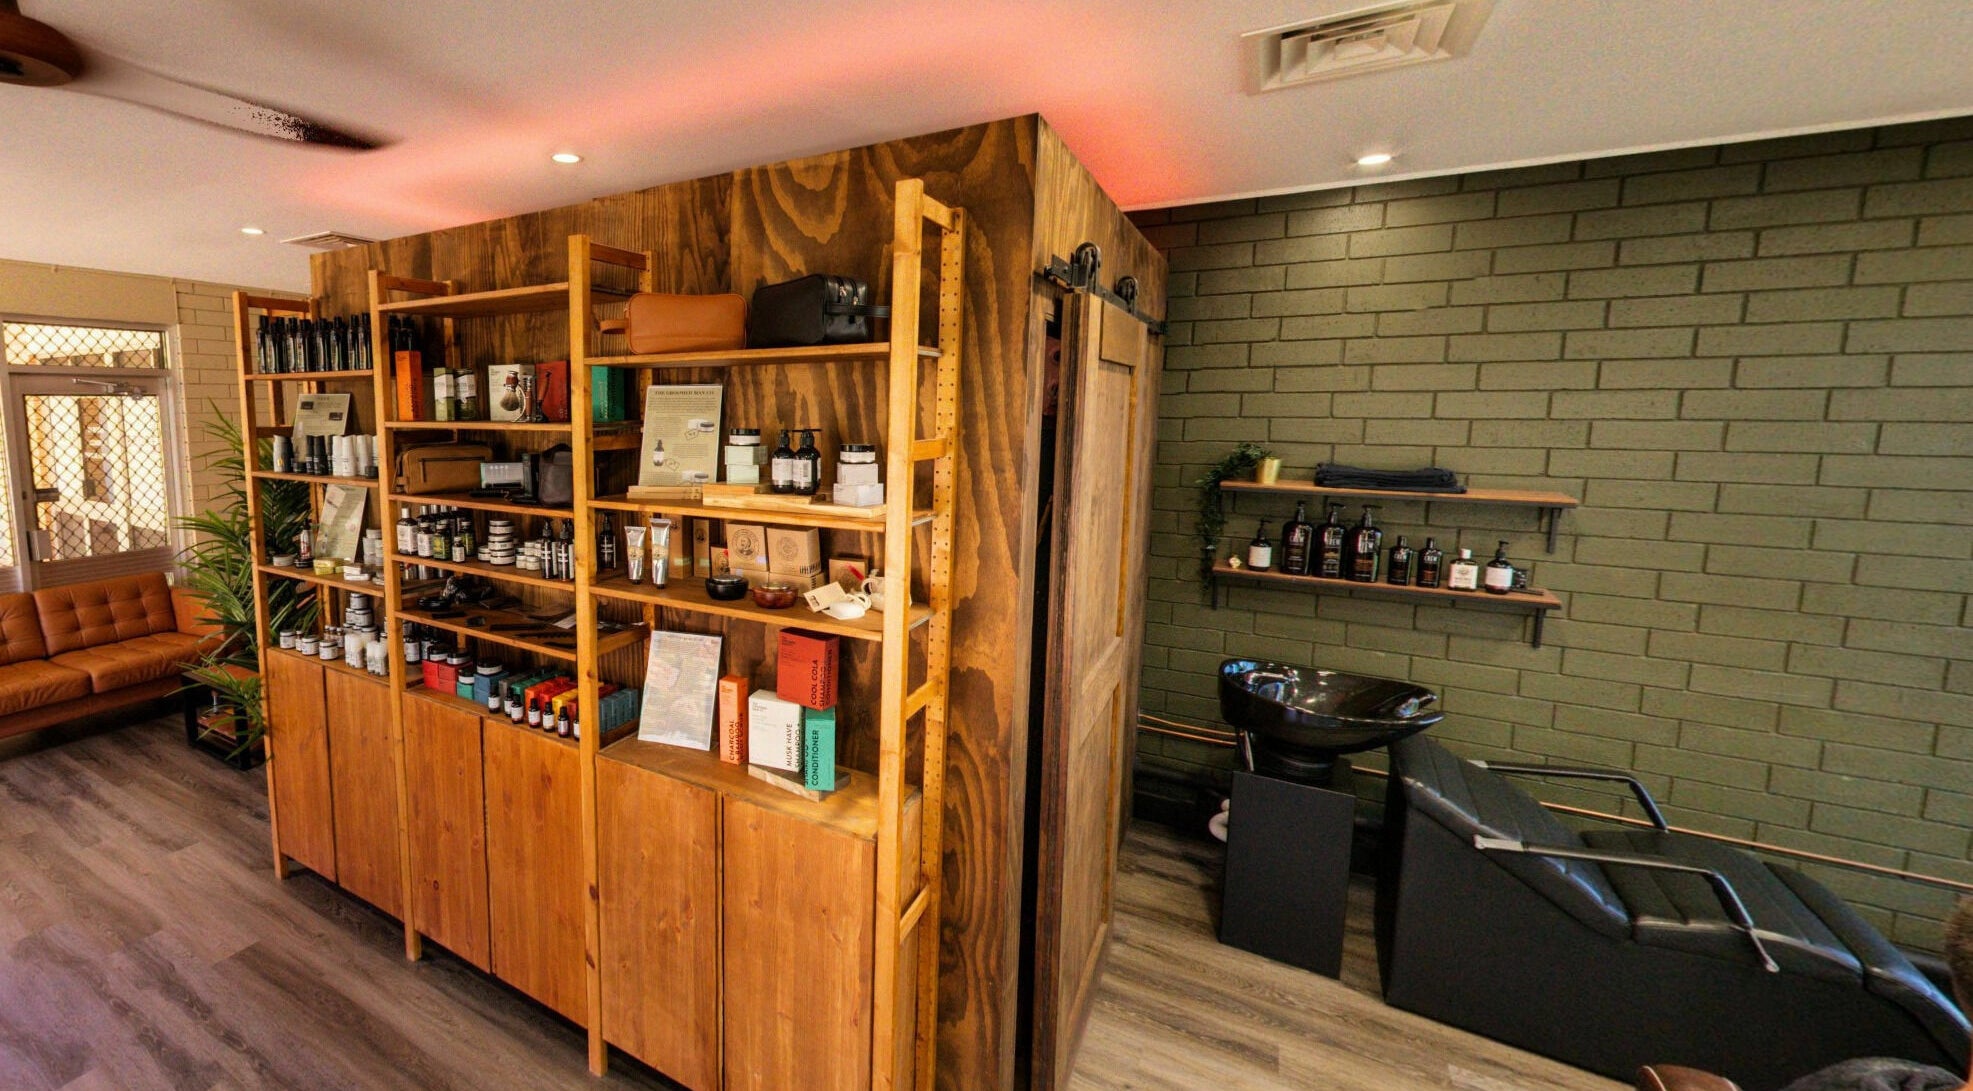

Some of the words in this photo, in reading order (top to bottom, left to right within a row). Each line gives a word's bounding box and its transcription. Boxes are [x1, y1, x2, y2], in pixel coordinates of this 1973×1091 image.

[810, 683, 818, 705] COOL
[785, 722, 793, 744] HAVE
[785, 746, 793, 767] MUSK
[811, 729, 819, 786] CONDITIONER
